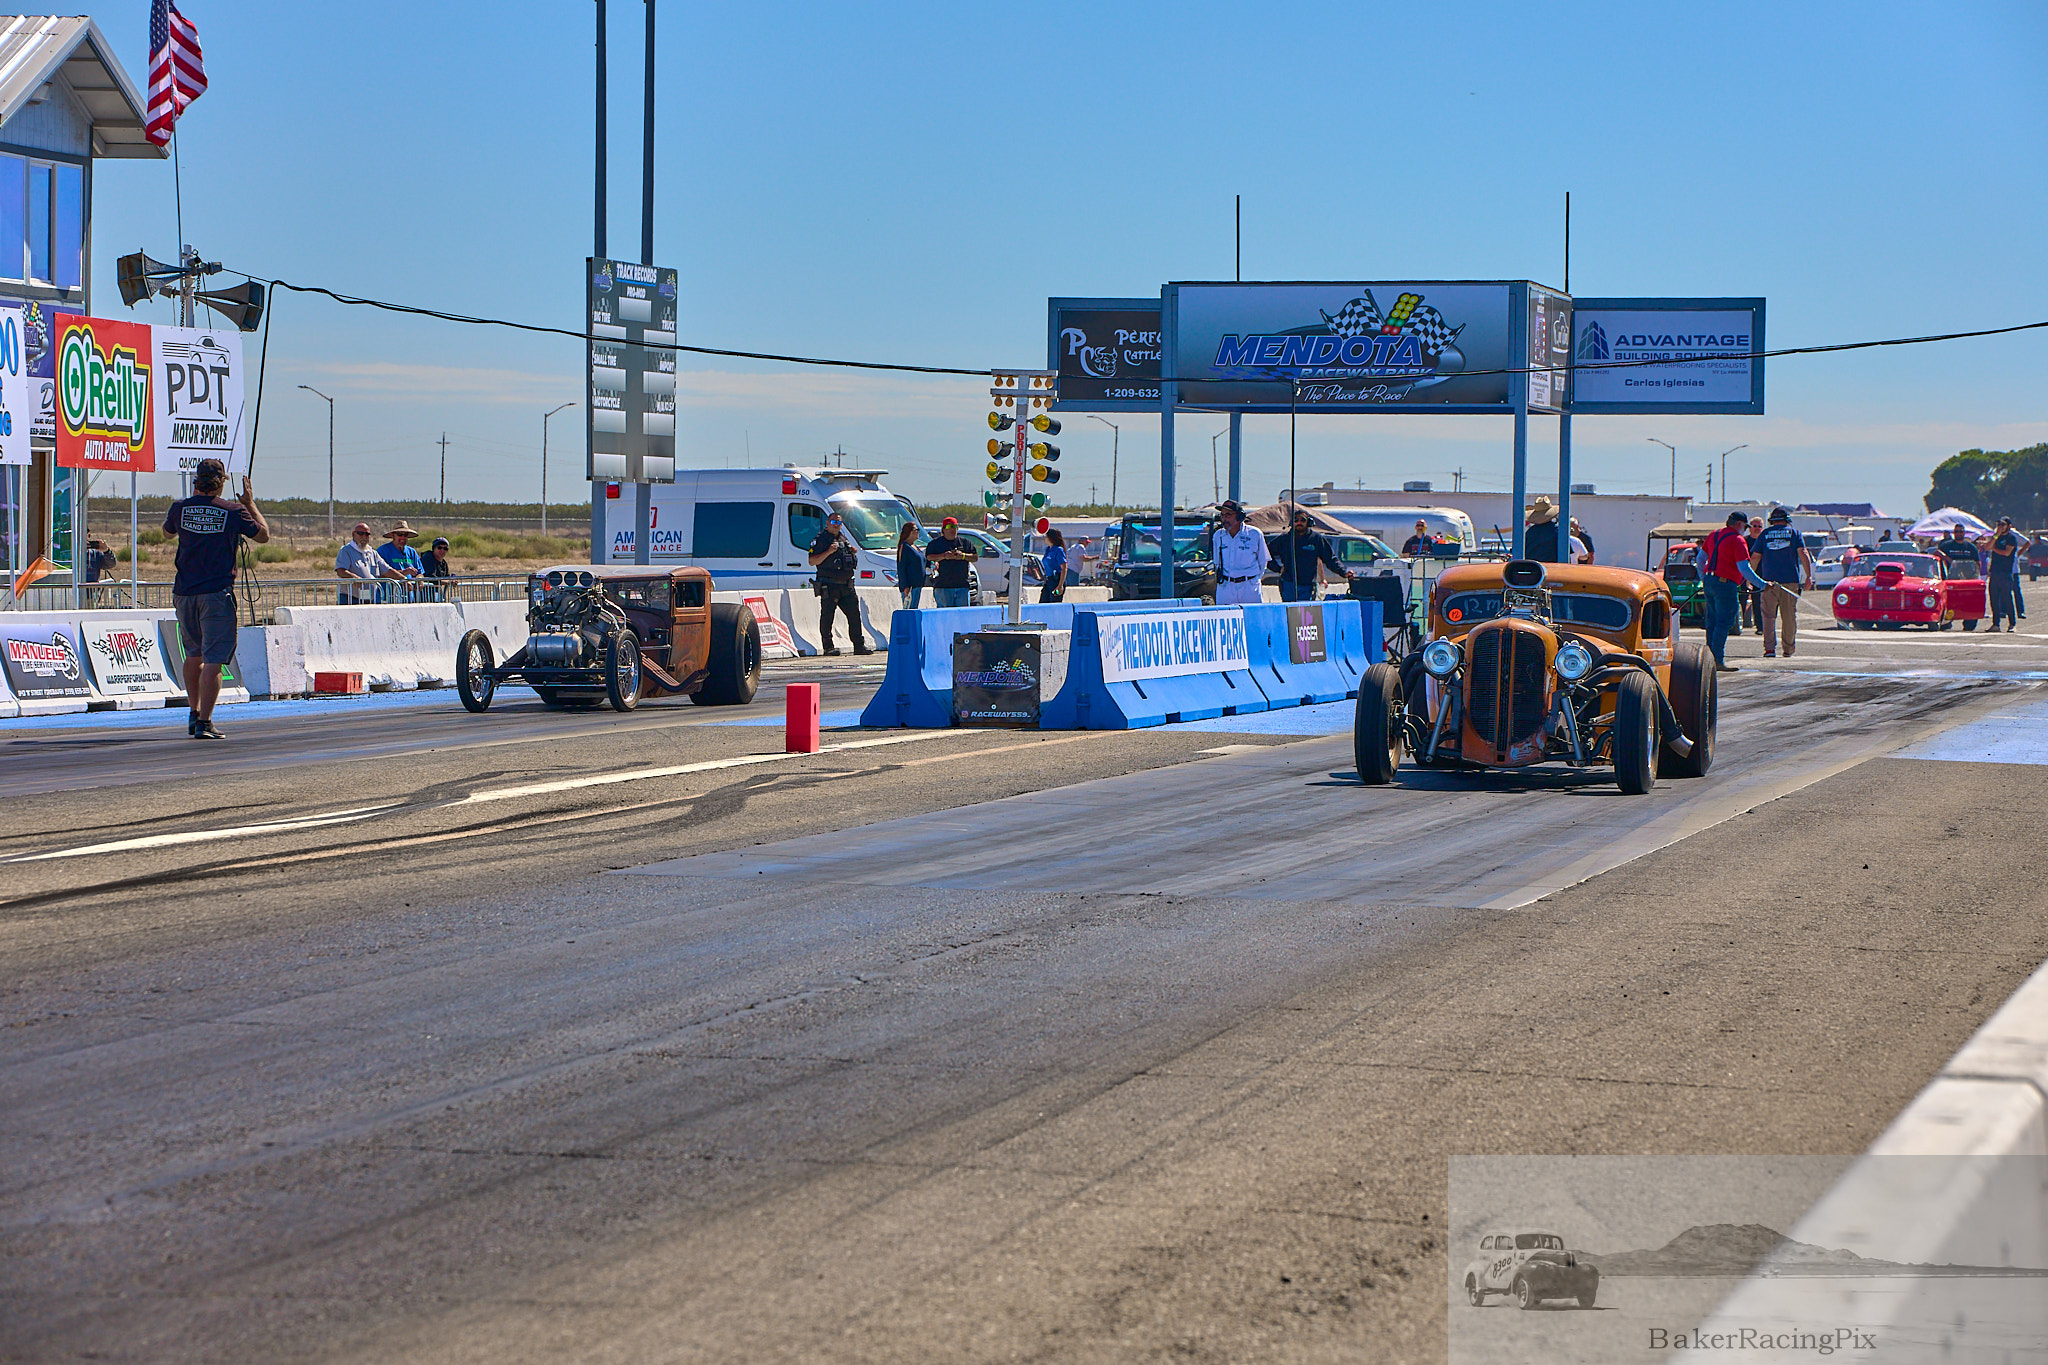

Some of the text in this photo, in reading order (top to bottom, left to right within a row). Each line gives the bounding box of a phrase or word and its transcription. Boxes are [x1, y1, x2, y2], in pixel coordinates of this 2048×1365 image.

[616, 263, 634, 280] TRACK
[634, 265, 657, 284] RECORDS
[1615, 335, 1749, 346] ADVANTAGE
[1214, 335, 1423, 366] MENDOTA
[1300, 368, 1381, 378] RACEWAY
[64, 342, 144, 434] O'Reilly
[1625, 379, 1705, 388] Carlos Iglesias
[1303, 384, 1412, 402] The Place to Race!
[172, 423, 228, 445] MOTOR SPORTS
[84, 440, 103, 460] AUTO
[205, 509, 225, 517] BUILT
[183, 522, 202, 530] HAND
[614, 531, 682, 543] AMICAN
[613, 544, 682, 552] AMBANCE
[1121, 617, 1247, 670] MENDOTA RACEWAY PARK
[9, 642, 65, 661] MANUELS
[956, 671, 1024, 682] MENDOTA
